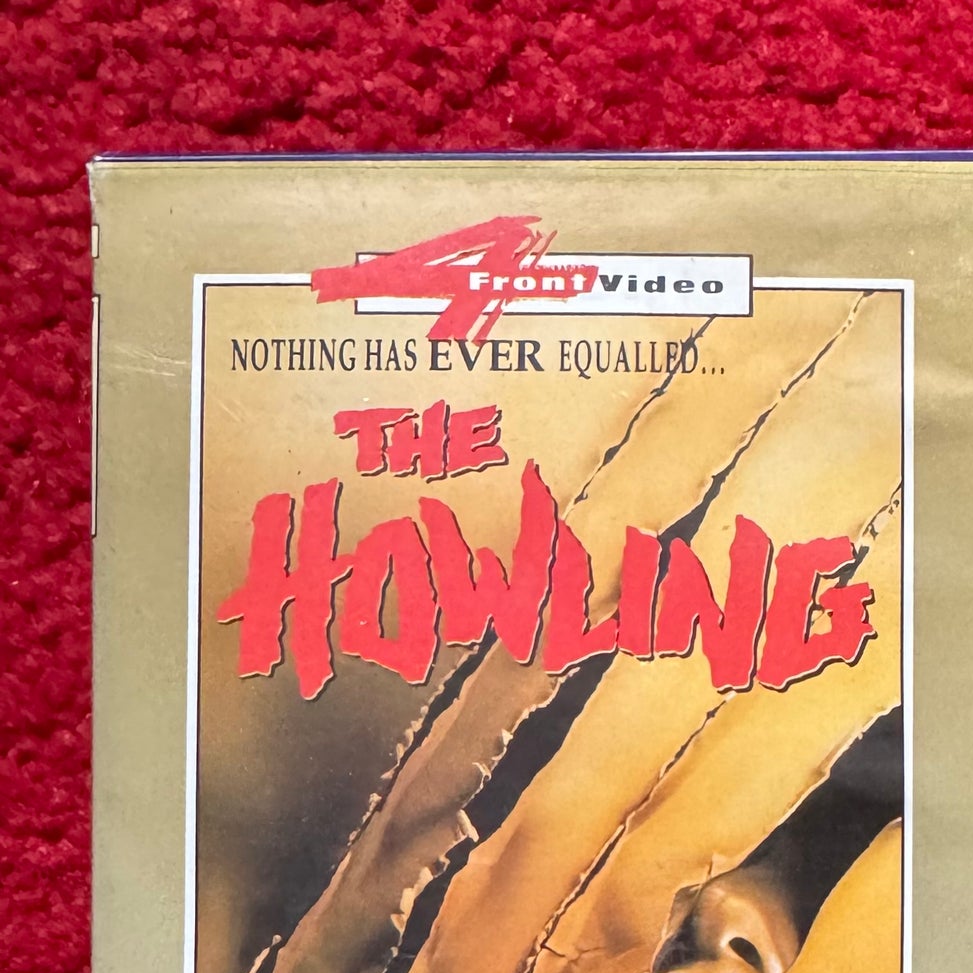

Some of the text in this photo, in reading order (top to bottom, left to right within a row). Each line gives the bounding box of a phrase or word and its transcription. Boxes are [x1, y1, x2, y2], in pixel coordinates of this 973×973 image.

[468, 270, 589, 293] Front
[598, 274, 725, 295] Video
[230, 338, 727, 379] NOTHING HAS EVER EQUALLED...
[333, 400, 509, 480] THE
[217, 458, 878, 701] HOWLING
